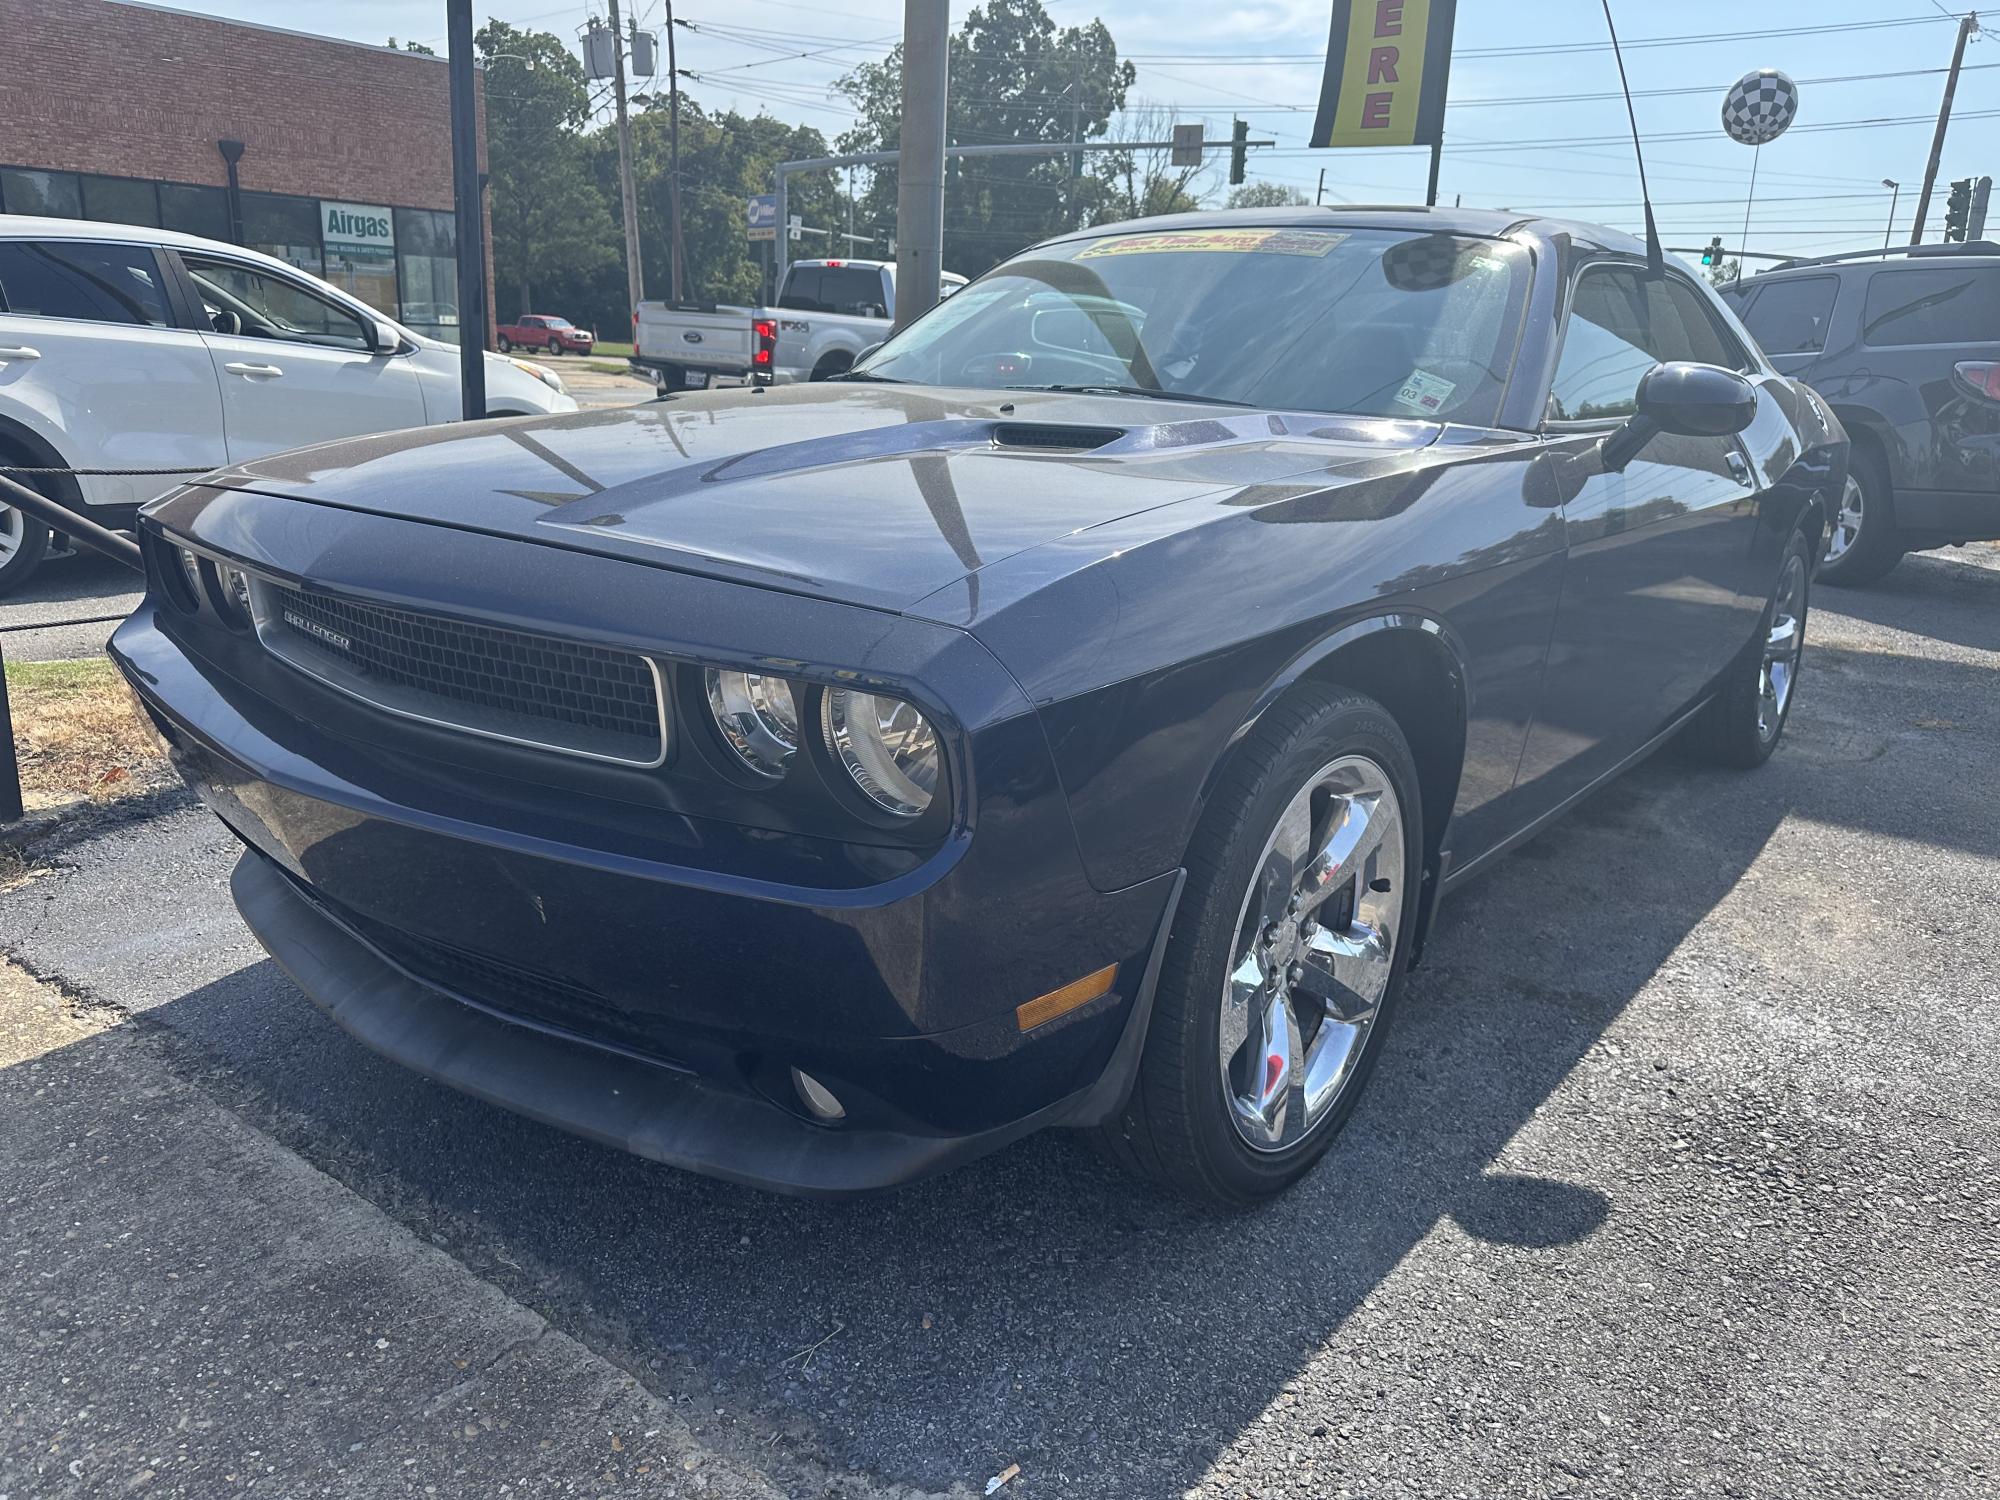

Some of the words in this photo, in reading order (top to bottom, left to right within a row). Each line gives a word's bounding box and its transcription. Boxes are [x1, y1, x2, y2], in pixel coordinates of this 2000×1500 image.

[327, 209, 390, 238] Airgas
[1401, 388, 1417, 400] 03
[284, 610, 350, 650] CHALLENGER
